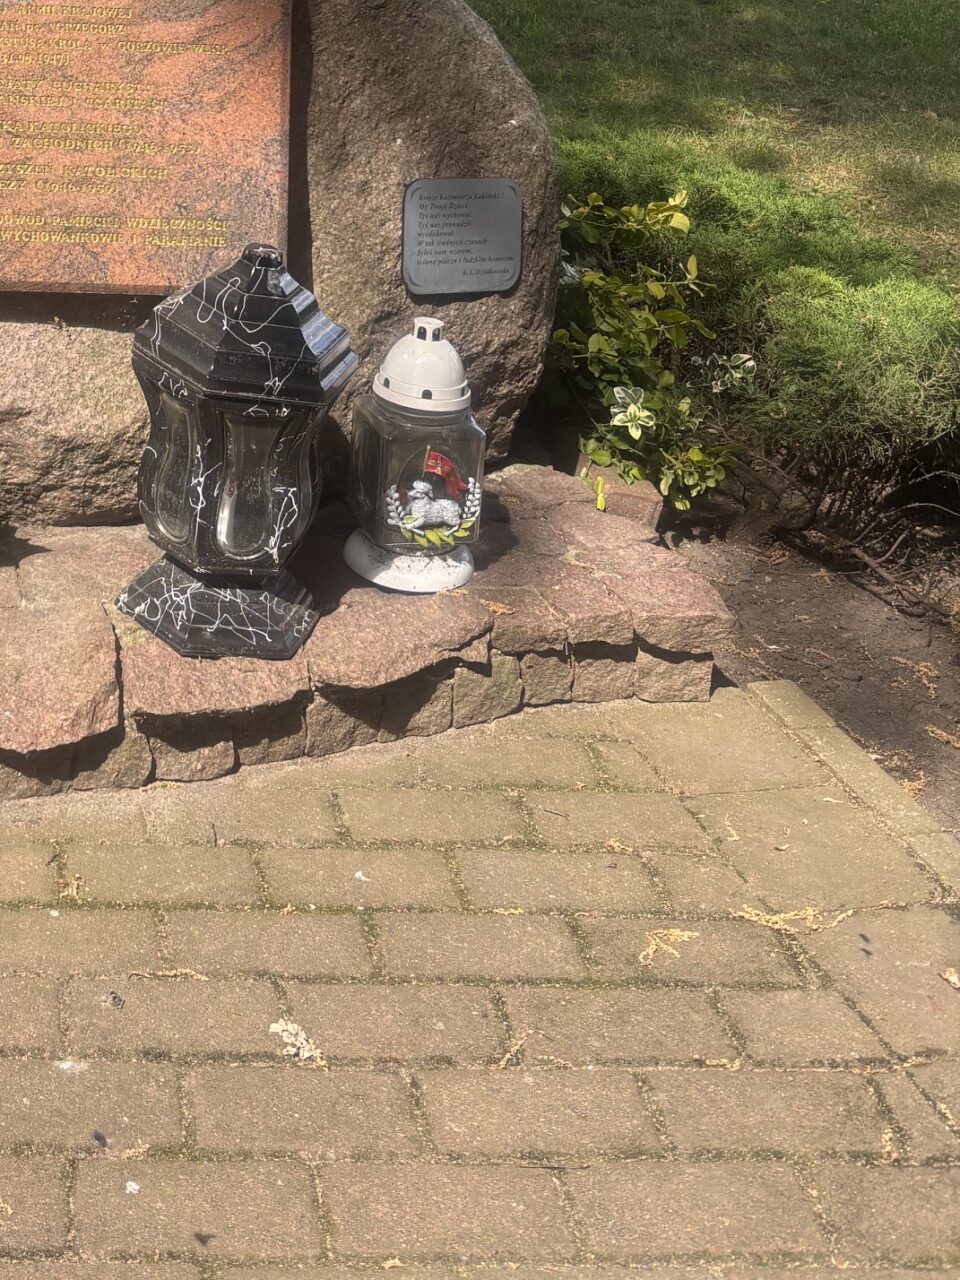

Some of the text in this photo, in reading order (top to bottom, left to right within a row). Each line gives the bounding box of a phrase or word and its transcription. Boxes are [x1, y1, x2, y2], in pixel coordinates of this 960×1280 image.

[17, 4, 55, 16] ARMII
[61, 6, 133, 18] KRAJOWEJ
[11, 138, 113, 151] ZACHODNICH
[63, 165, 168, 178] KATOLICKICH
[126, 218, 227, 232] WDZIĘCZNOŚCI
[1, 231, 124, 244] WYCHOWANKOWIE
[145, 235, 227, 249] PARAFIANIE
